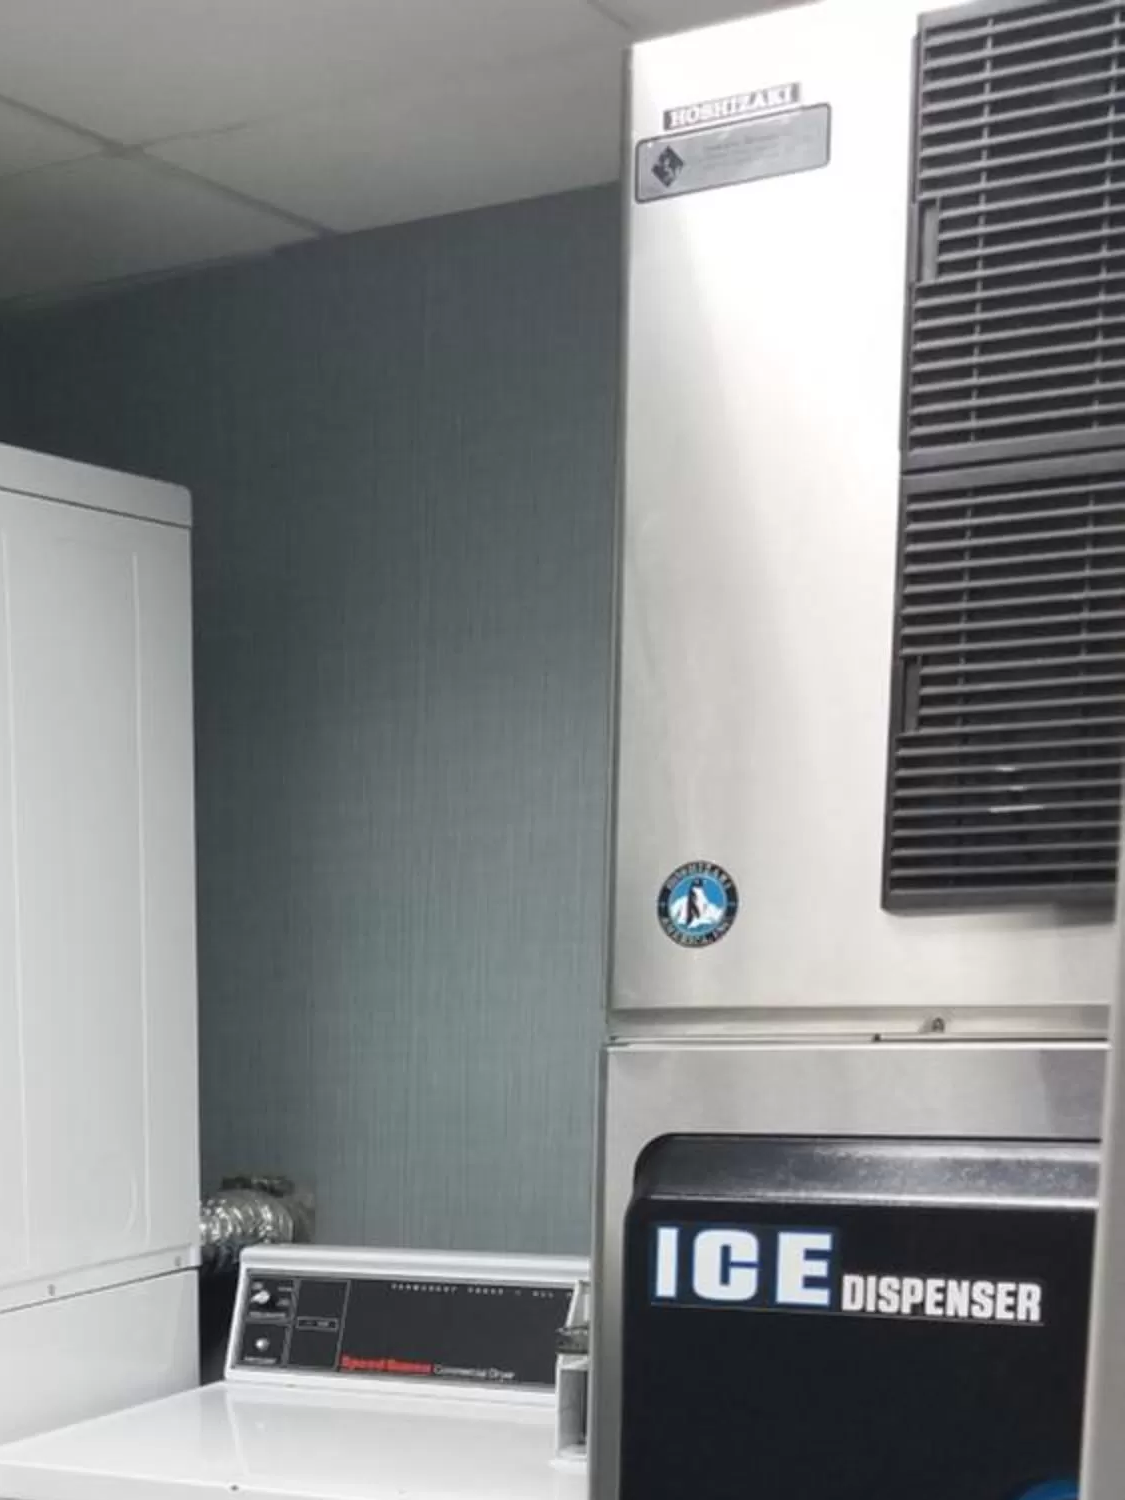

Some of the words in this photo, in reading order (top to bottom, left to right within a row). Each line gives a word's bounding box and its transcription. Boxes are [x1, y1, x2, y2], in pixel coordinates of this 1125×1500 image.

[669, 86, 793, 129] HOSHIZAKI
[655, 1226, 833, 1306] ICE
[842, 1274, 1043, 1322] DISPENSER
